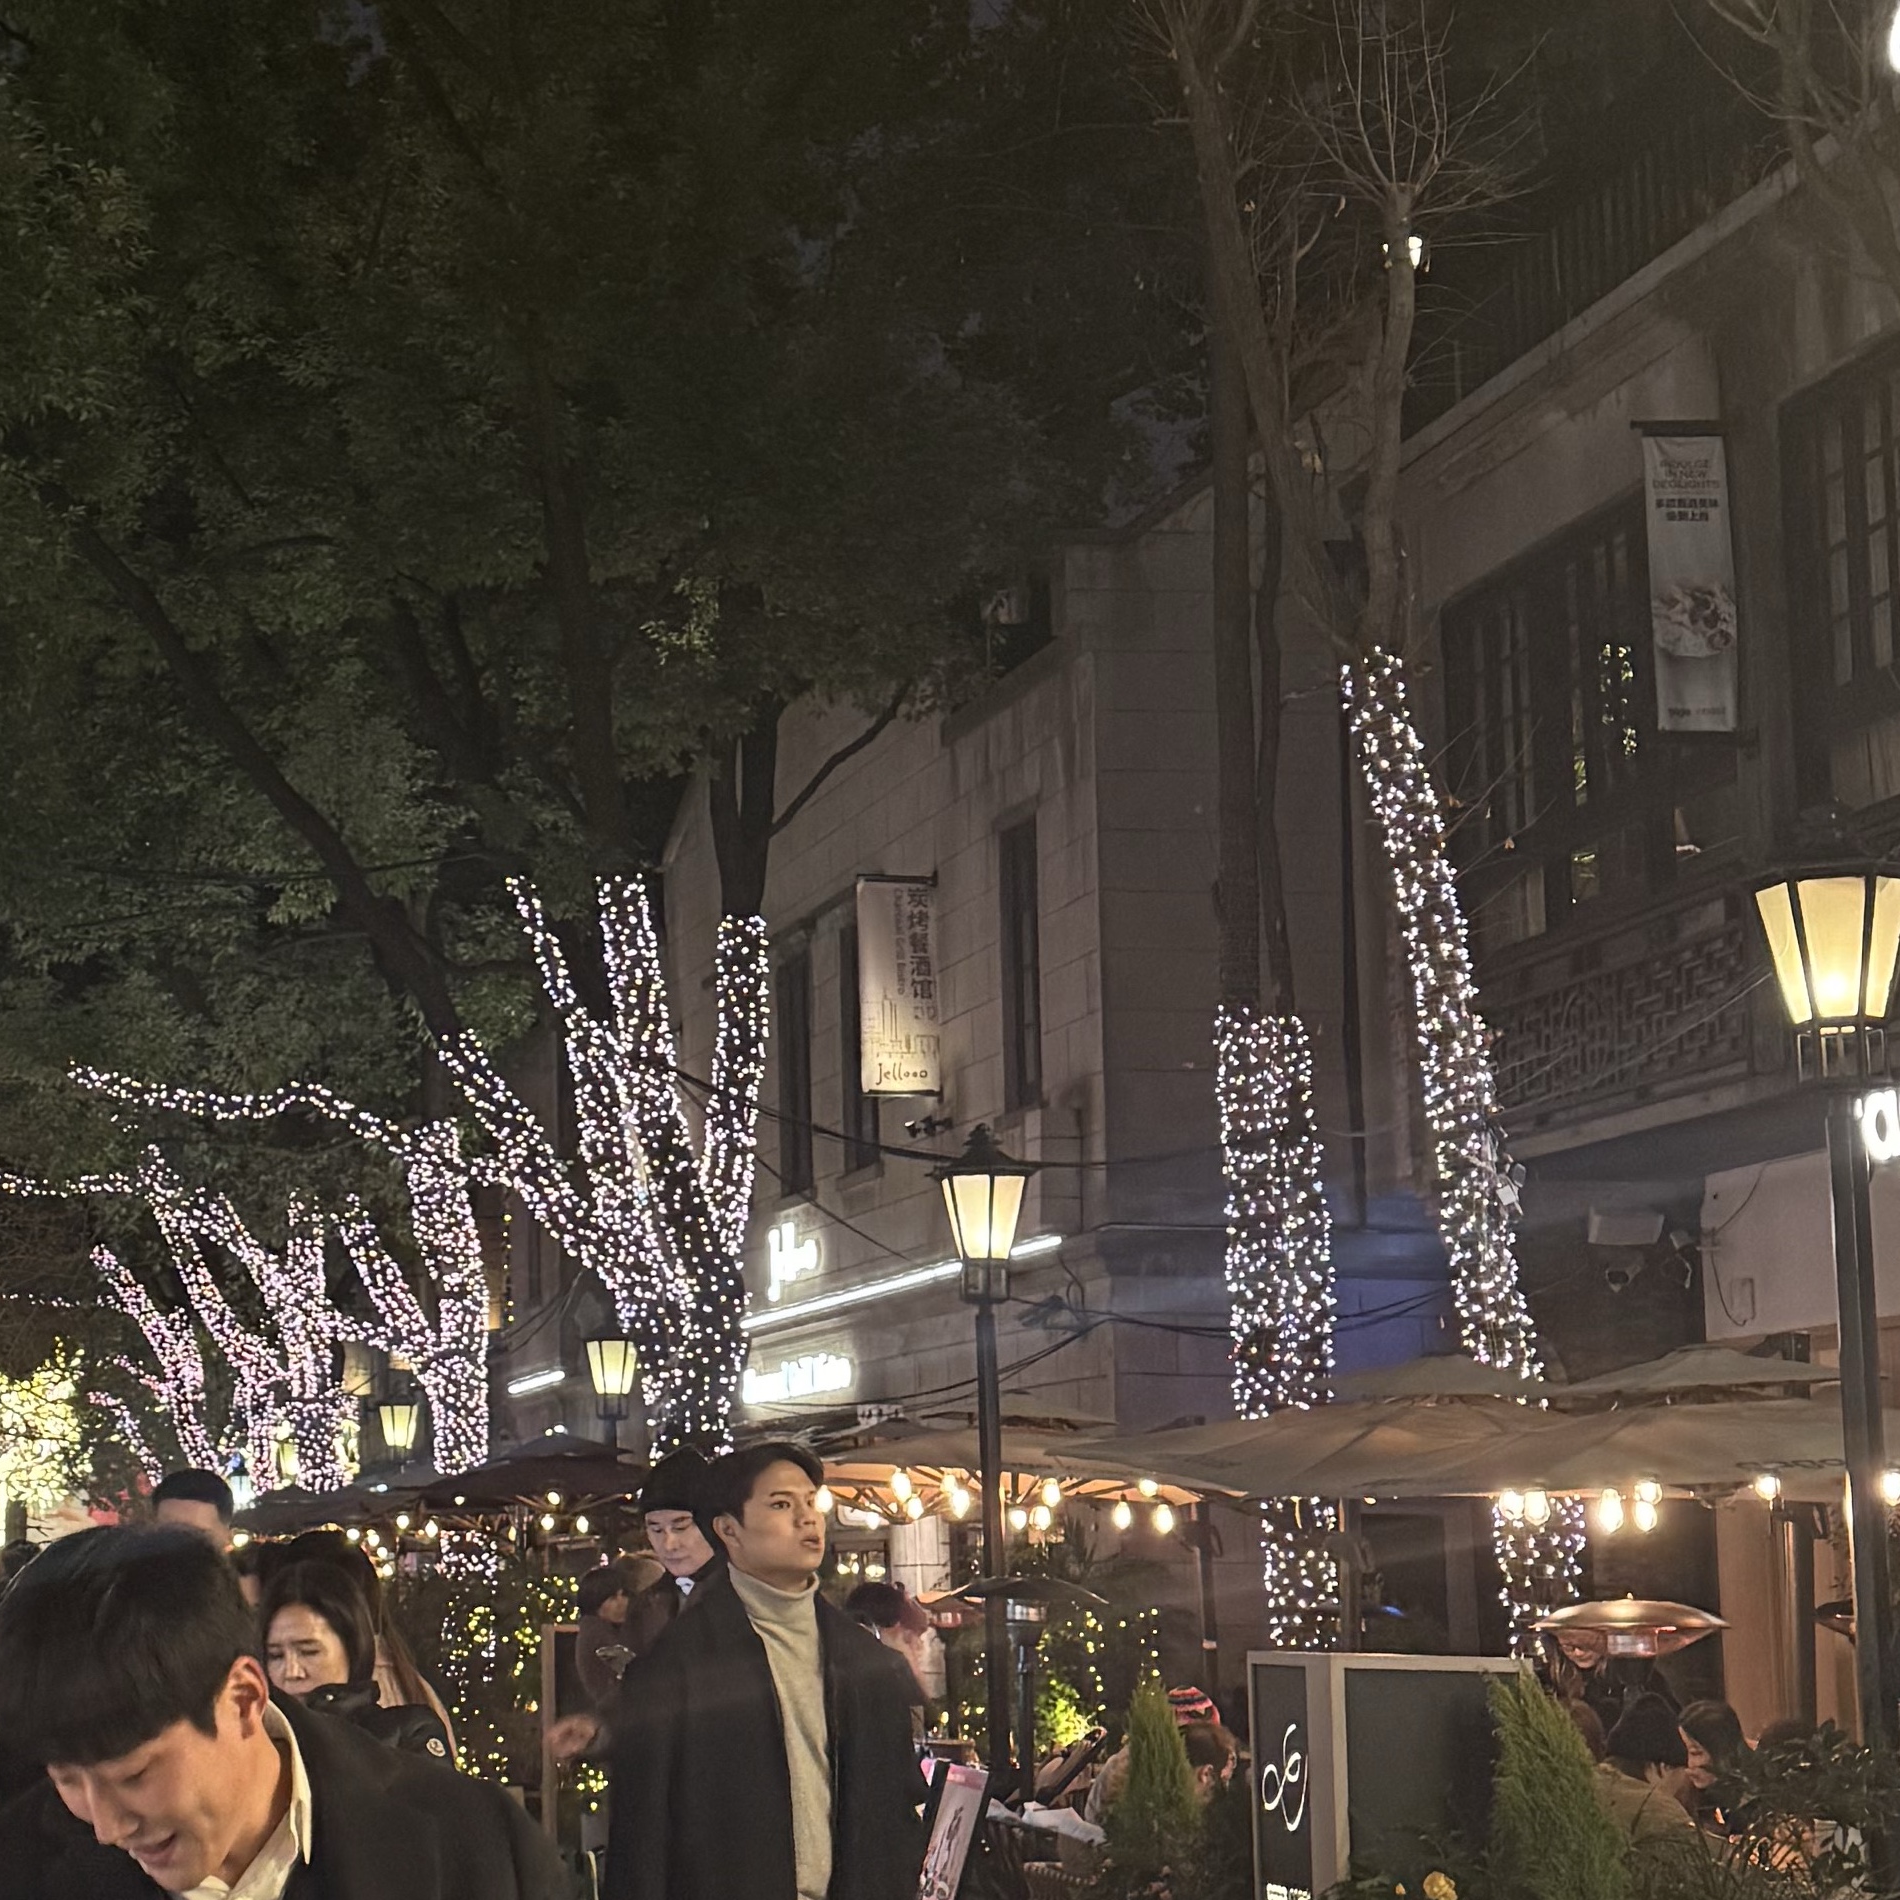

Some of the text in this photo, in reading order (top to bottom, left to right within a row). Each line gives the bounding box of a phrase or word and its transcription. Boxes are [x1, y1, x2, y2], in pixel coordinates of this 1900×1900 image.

[908, 886, 933, 999] 炭烤餐酒馆
